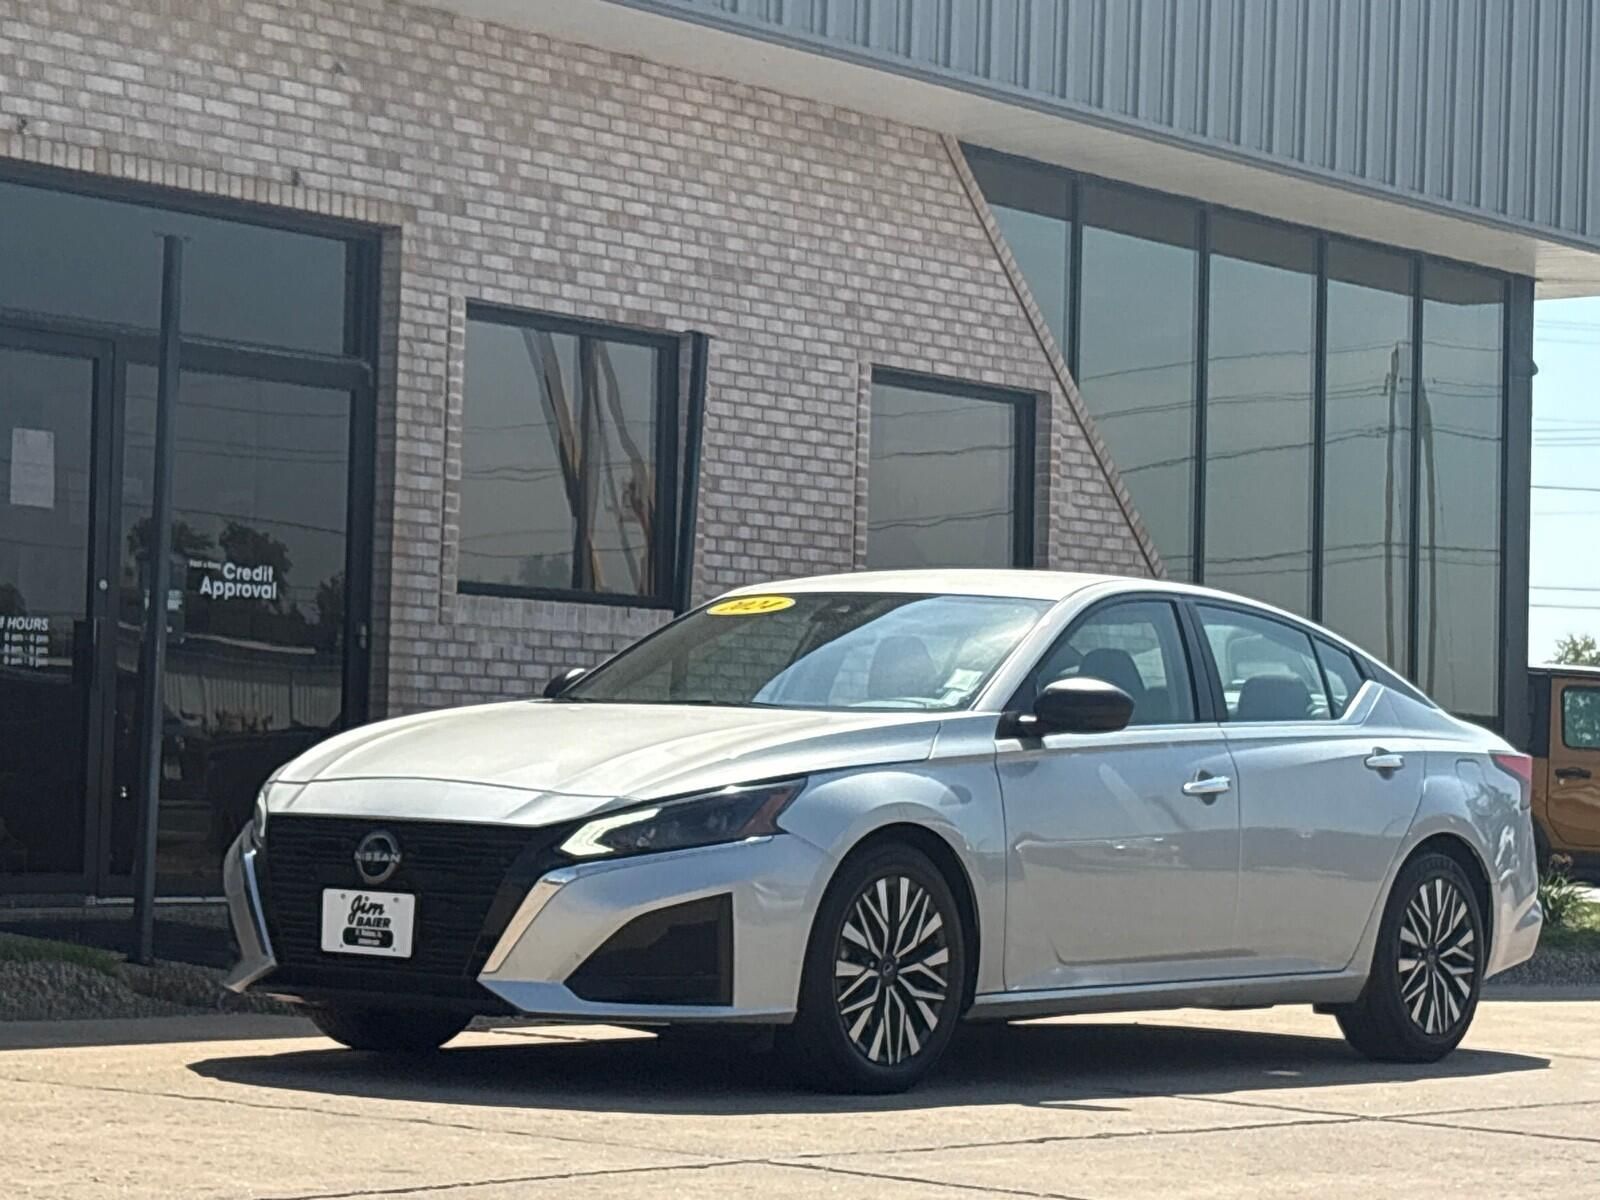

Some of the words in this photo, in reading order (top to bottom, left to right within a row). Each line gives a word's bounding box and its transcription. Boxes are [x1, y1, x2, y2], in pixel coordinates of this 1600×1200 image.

[223, 562, 273, 582] Credit
[200, 575, 277, 600] Approval
[7, 616, 49, 631] HOURS
[347, 894, 385, 926] Jim
